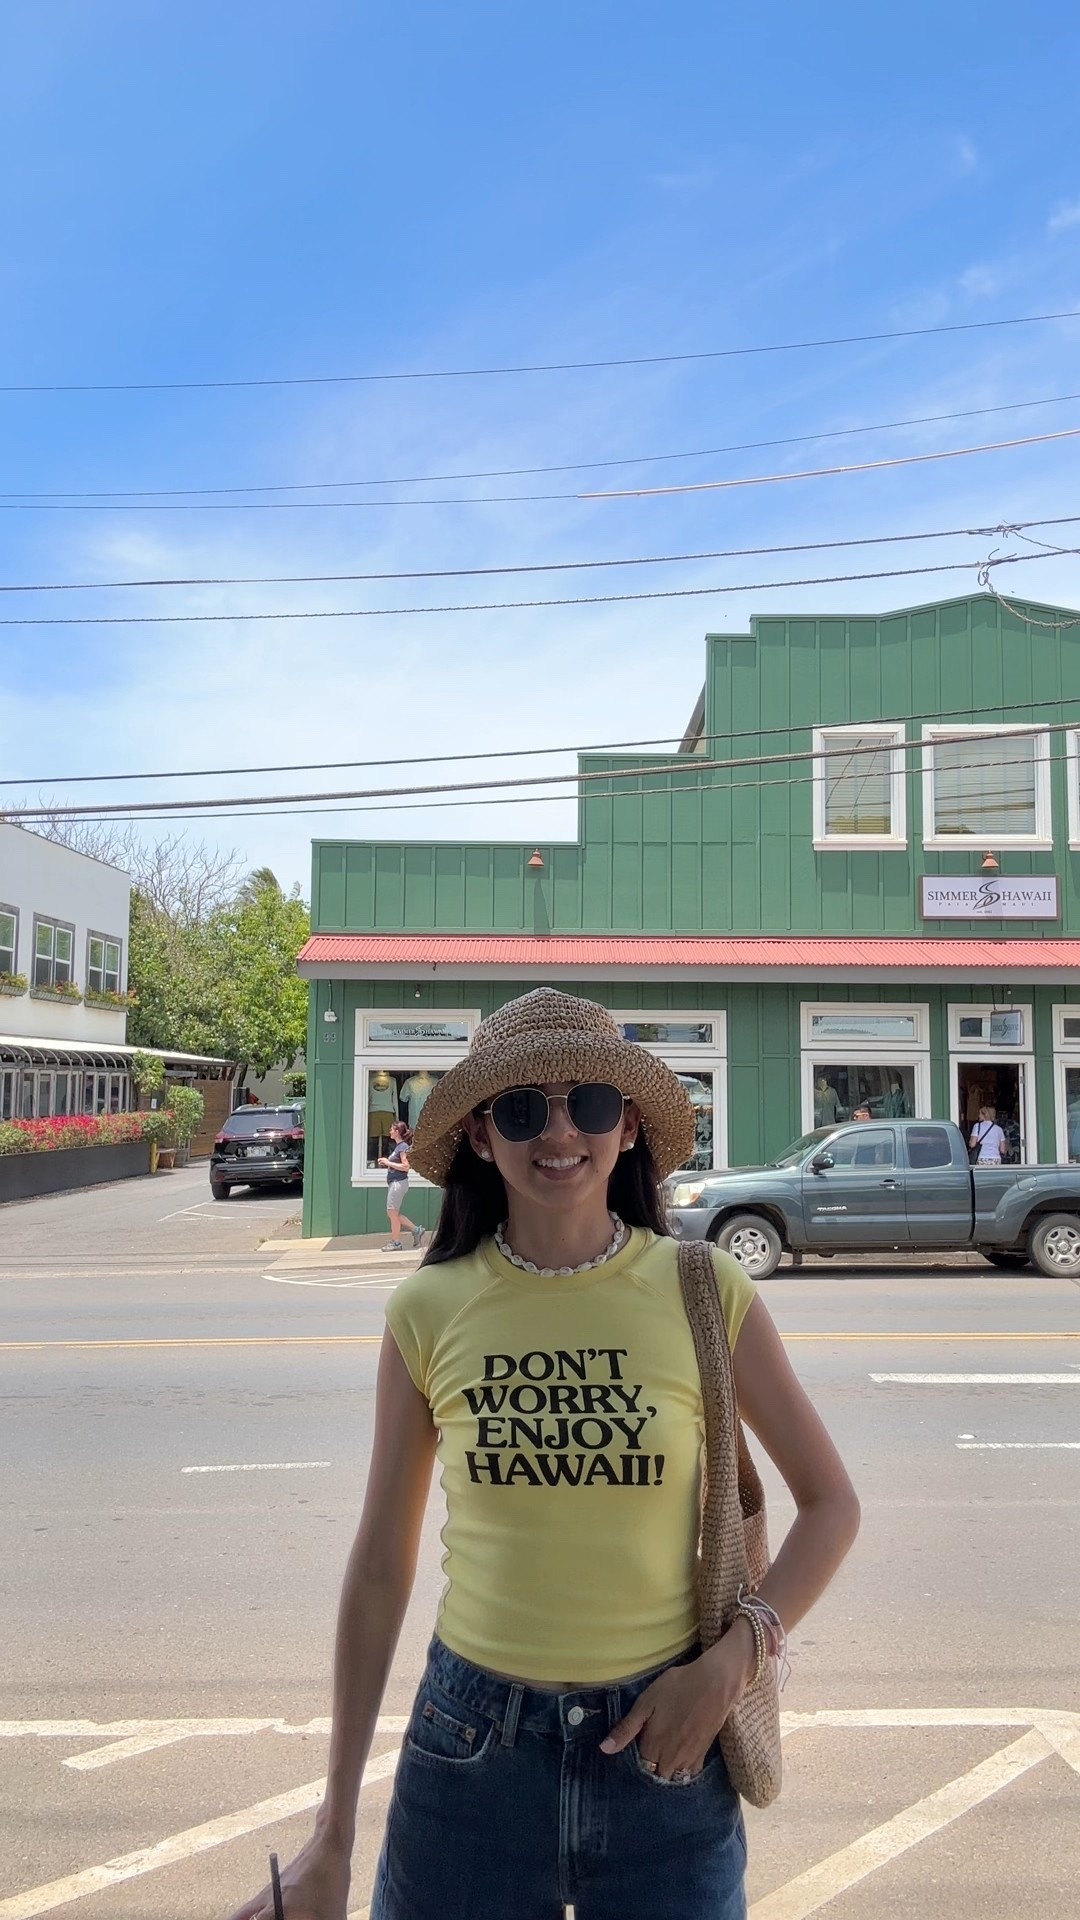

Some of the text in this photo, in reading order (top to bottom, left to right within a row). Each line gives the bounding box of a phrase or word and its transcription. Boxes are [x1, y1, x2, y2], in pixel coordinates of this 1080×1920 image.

[927, 891, 1052, 901] SIMMER HAWAII
[481, 1348, 628, 1381] DON'T
[461, 1384, 658, 1418] WORRY,
[476, 1417, 647, 1450] ENJOY
[464, 1451, 665, 1487] HAWAII!
